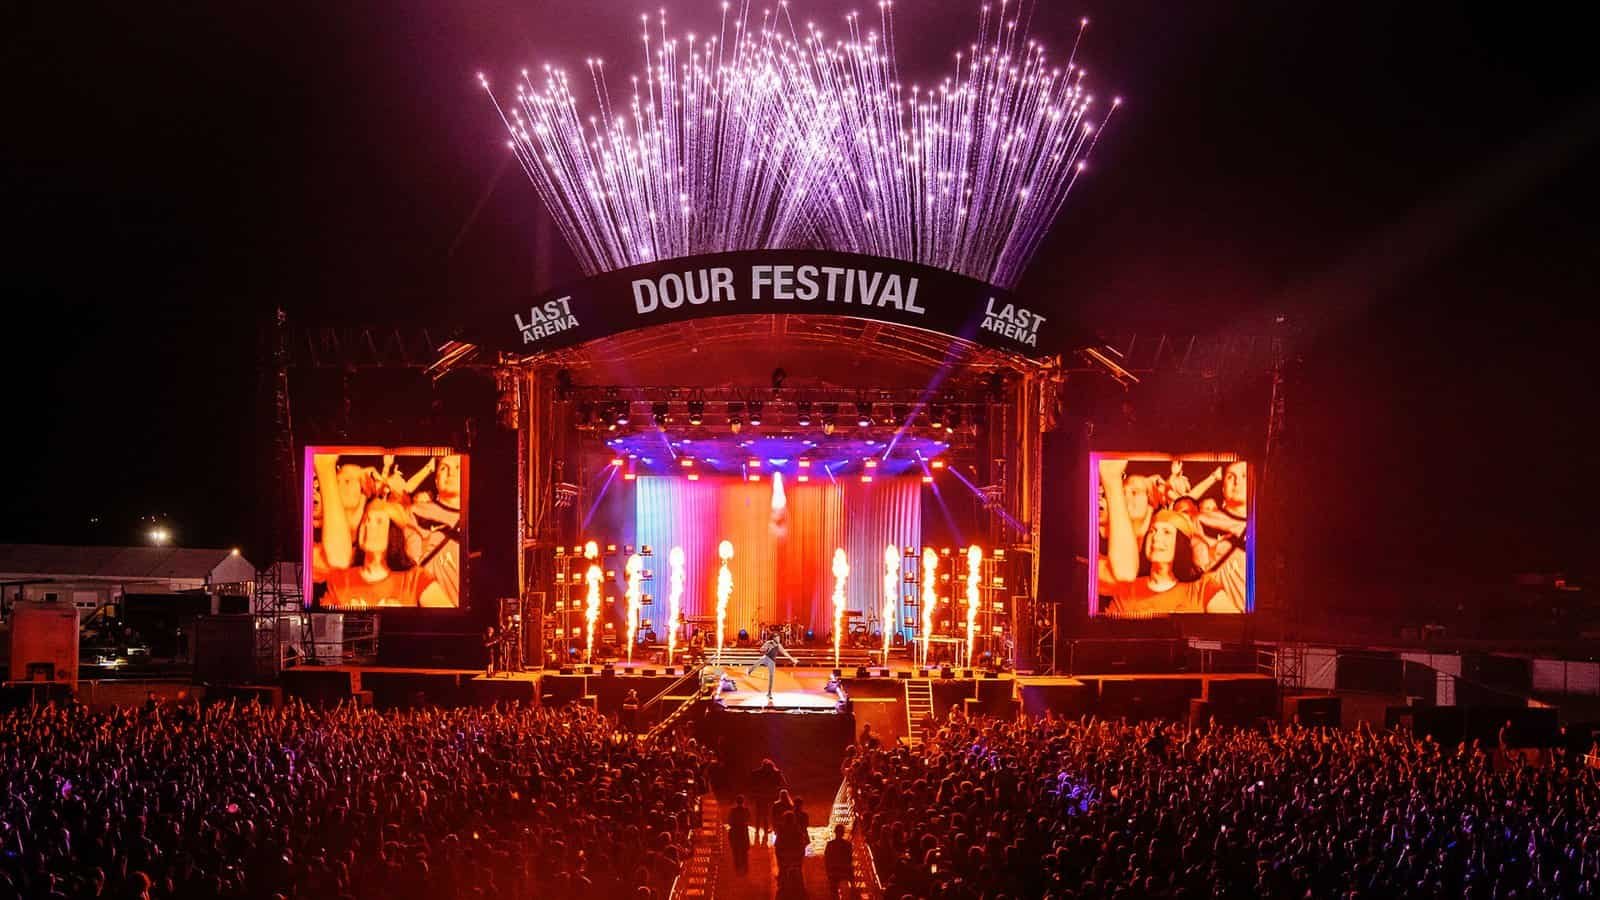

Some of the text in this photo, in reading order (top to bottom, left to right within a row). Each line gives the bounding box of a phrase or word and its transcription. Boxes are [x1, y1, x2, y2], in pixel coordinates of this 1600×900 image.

[631, 265, 926, 315] DOUR FESTIVAL
[514, 295, 571, 332] LAST
[523, 314, 580, 344] ARENA
[980, 316, 1037, 347] ARENA
[985, 297, 1047, 333] LAST
